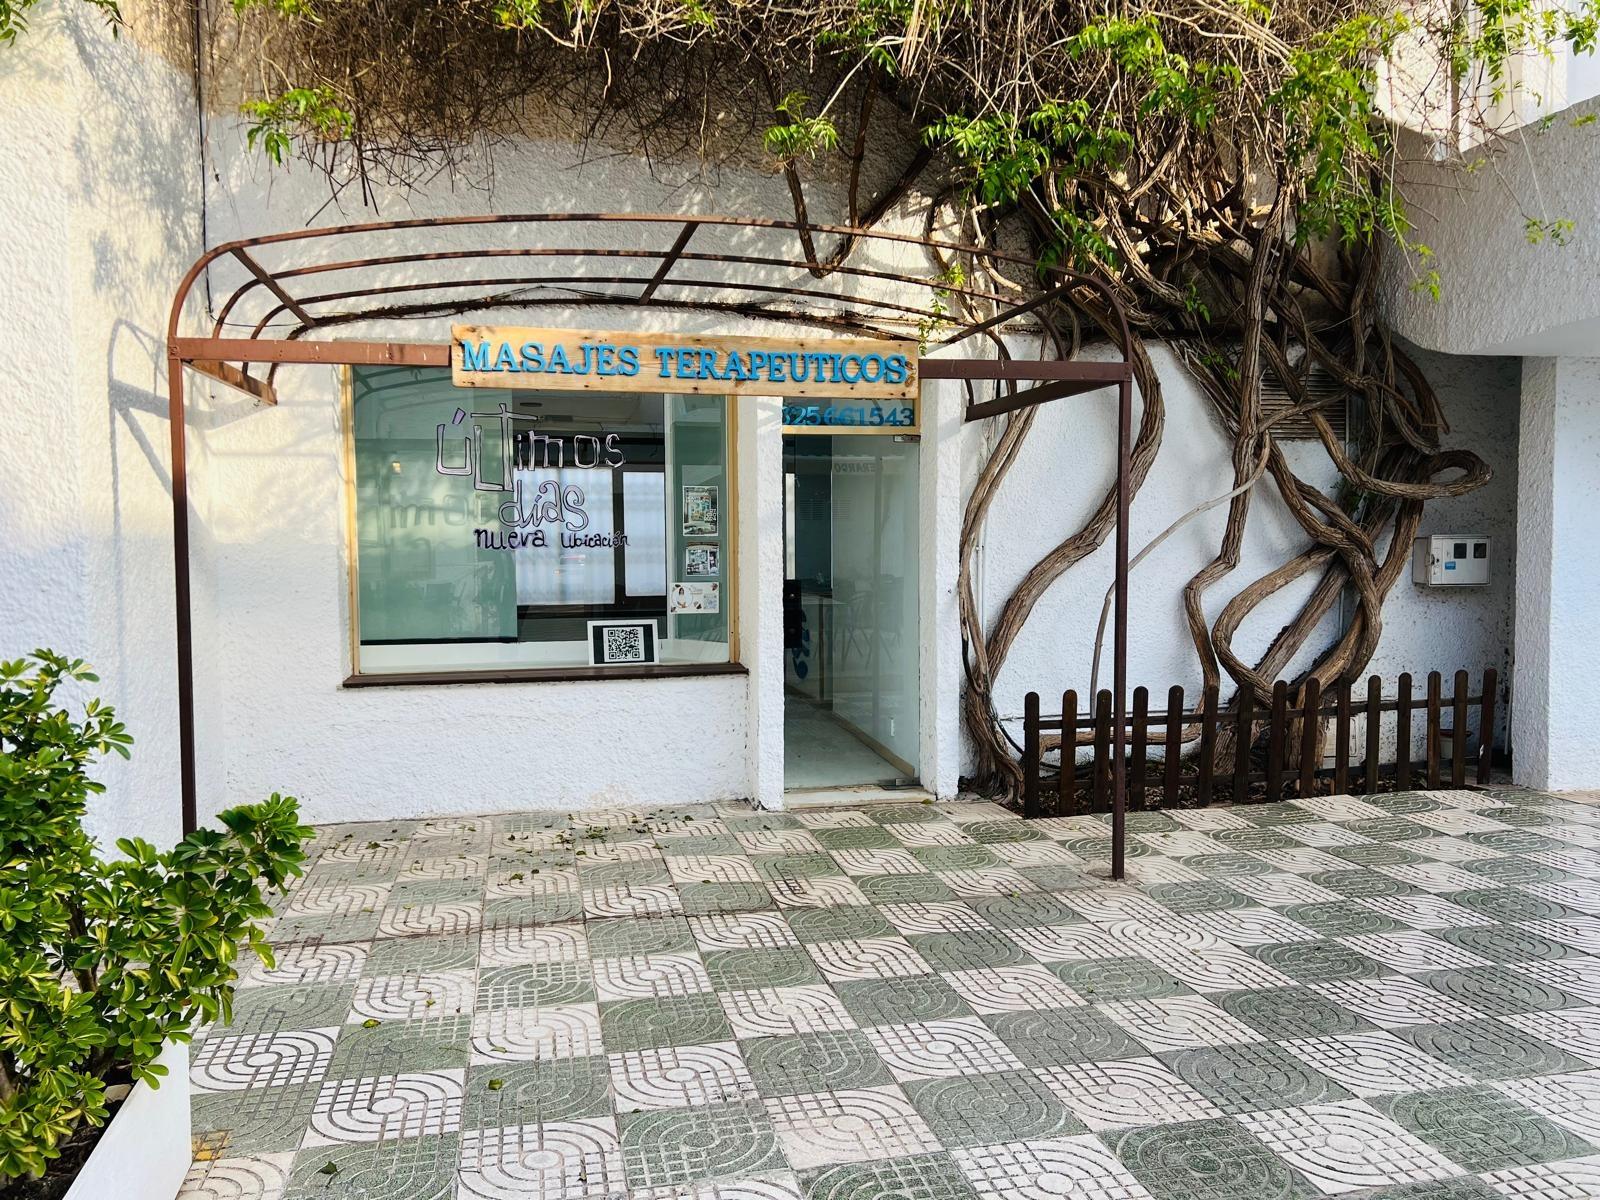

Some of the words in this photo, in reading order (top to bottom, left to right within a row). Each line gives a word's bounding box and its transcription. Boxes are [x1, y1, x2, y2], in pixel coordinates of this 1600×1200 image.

[462, 340, 641, 376] MASAJES
[655, 347, 908, 384] TERAPEUTICOS
[498, 475, 590, 531] días
[474, 528, 548, 550] nueva
